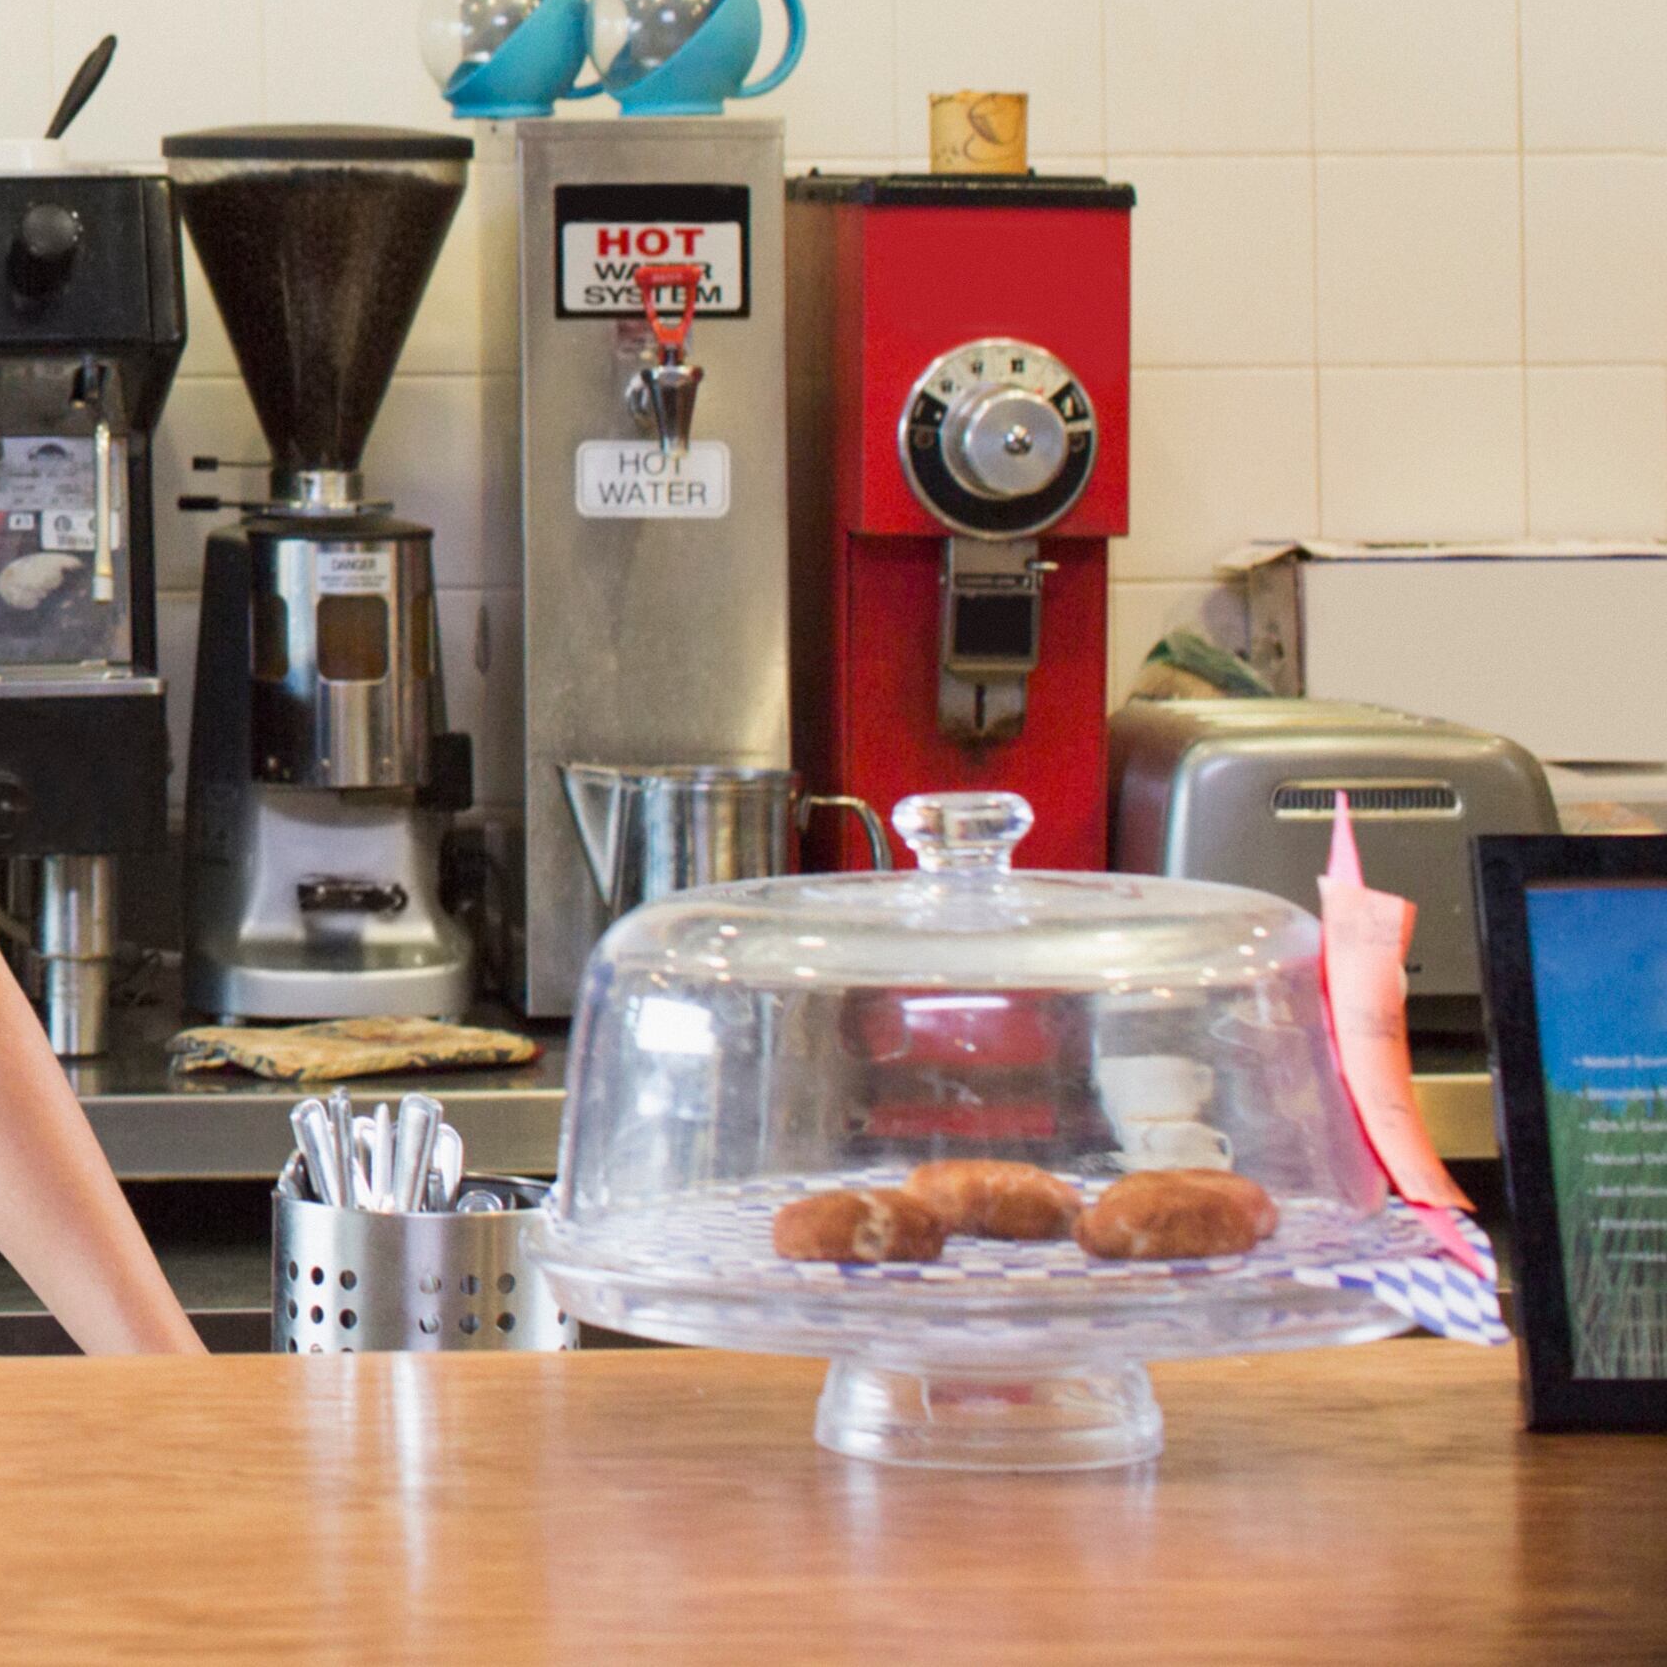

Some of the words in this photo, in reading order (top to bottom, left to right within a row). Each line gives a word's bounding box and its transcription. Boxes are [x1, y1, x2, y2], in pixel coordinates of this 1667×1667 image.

[596, 227, 705, 258] HOT
[618, 450, 682, 476] HOT
[598, 483, 708, 506] WATER
